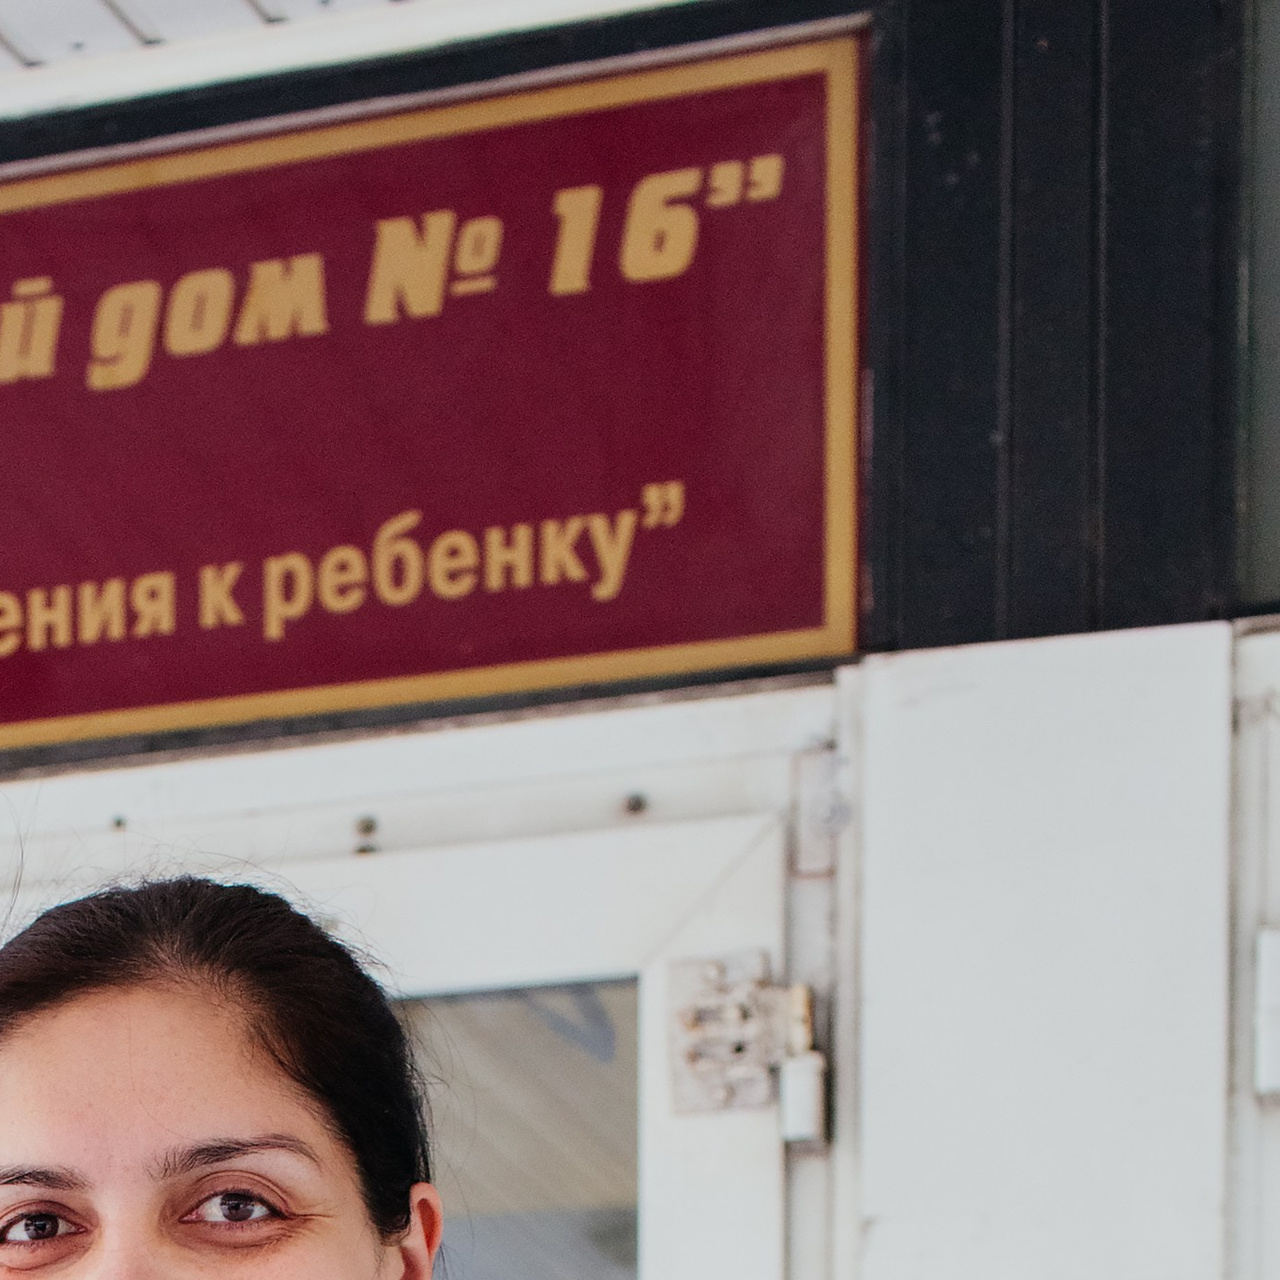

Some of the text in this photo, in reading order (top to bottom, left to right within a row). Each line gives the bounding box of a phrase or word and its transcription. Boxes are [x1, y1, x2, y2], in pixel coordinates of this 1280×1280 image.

[85, 252, 328, 391] дом
[364, 210, 503, 325] №
[198, 561, 244, 629] к
[263, 480, 685, 641] ребенку”
